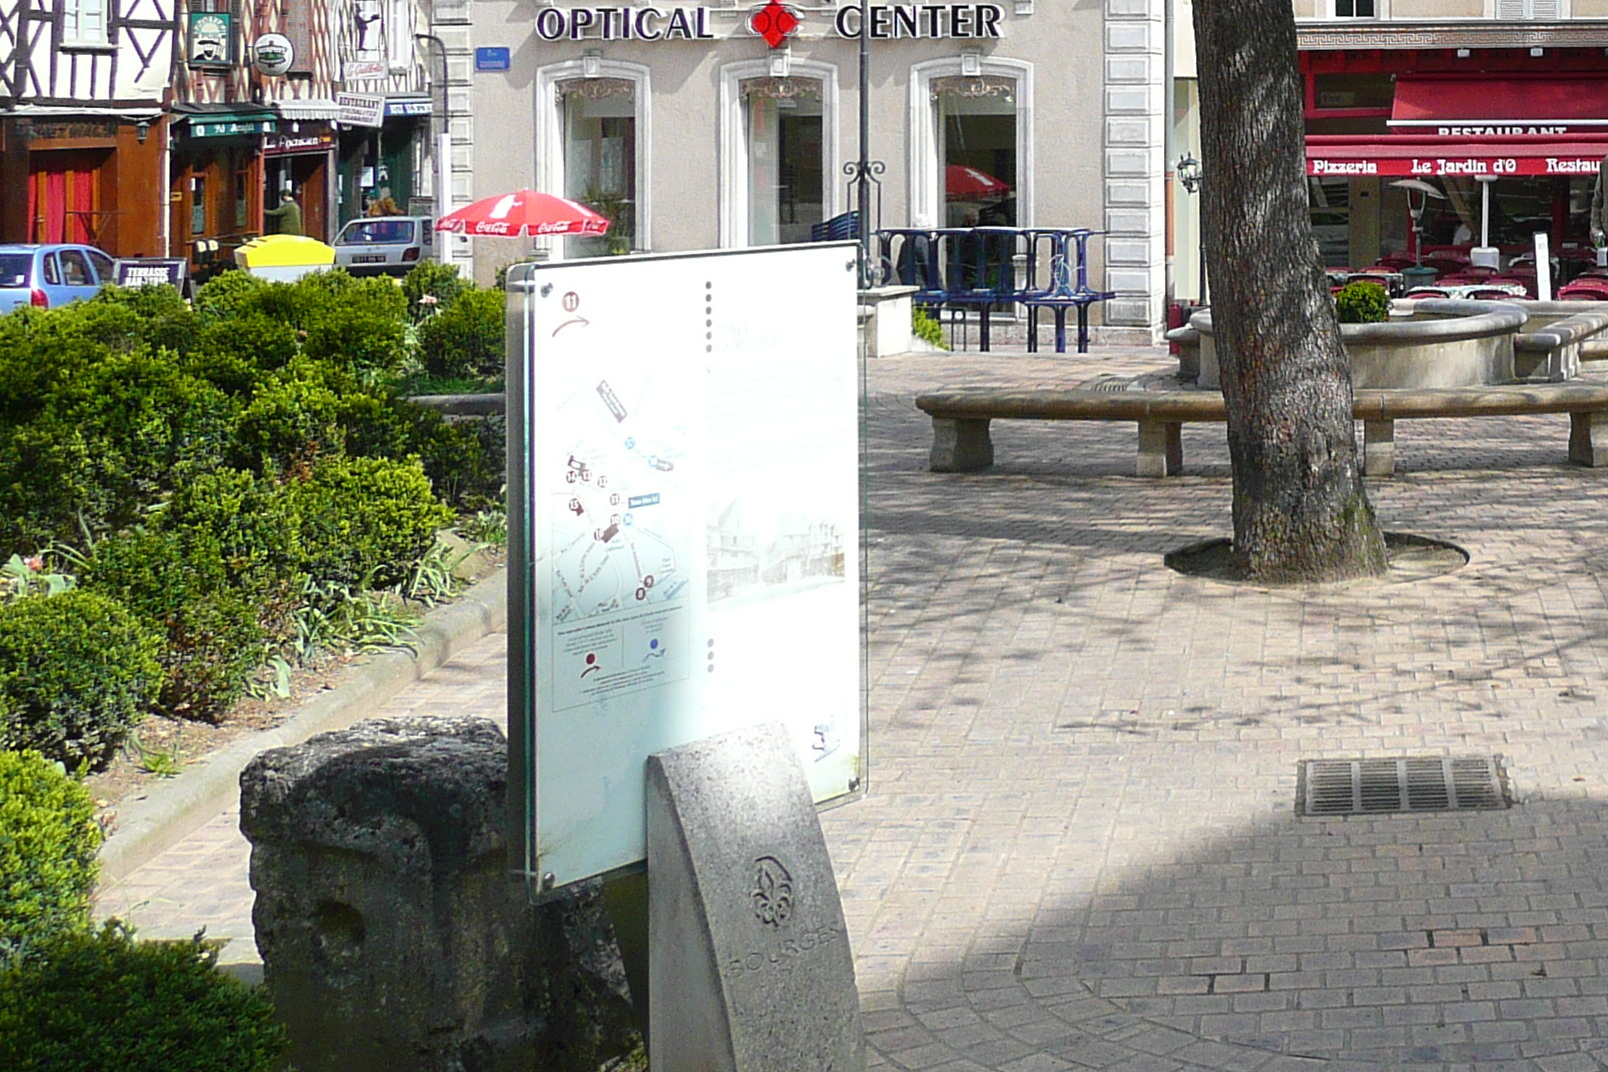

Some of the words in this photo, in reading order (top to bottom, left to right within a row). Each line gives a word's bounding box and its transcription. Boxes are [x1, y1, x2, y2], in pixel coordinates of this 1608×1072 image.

[536, 7, 715, 40] OPTICAL
[835, 5, 1003, 38] CENTER
[1312, 159, 1378, 174] Pizzeria
[1410, 158, 1432, 174] Le
[1436, 158, 1488, 175] Jardin
[1545, 158, 1601, 173] Restau
[722, 926, 840, 978] BOURGES
